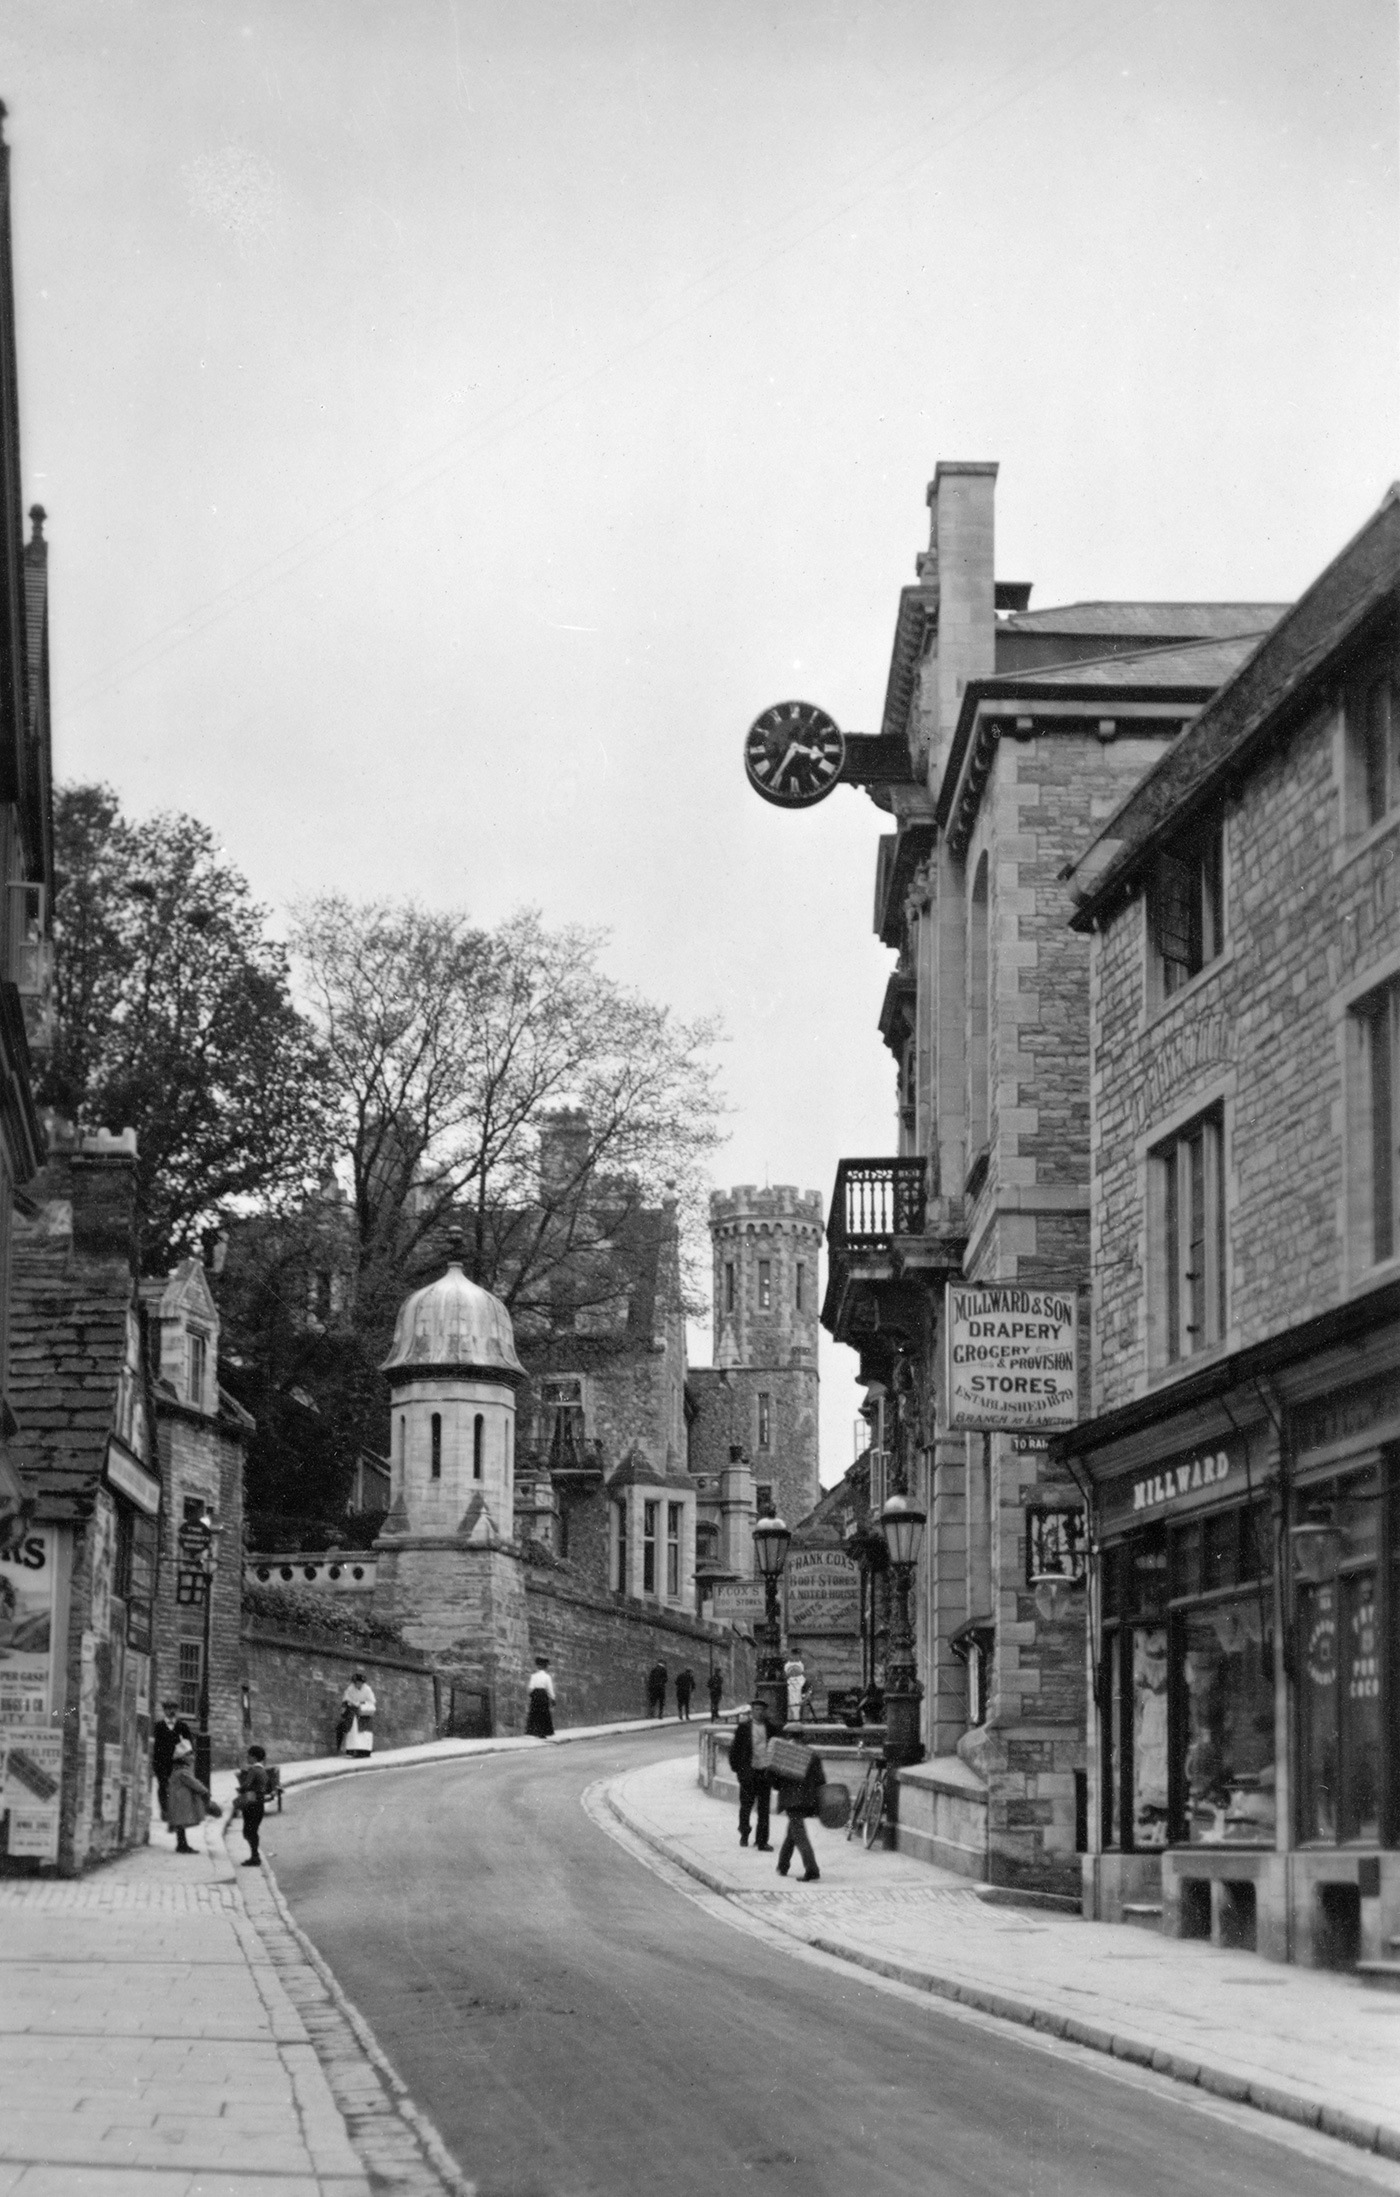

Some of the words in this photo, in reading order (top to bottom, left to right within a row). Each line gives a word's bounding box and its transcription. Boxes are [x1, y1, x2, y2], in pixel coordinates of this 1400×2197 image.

[953, 1291, 1030, 1324] MILLWARD
[1031, 1297, 1043, 1316] &
[1044, 1296, 1072, 1327] SON
[969, 1321, 1063, 1340] DRAPERY
[953, 1344, 1031, 1364] GROCERY
[997, 1358, 1007, 1369] &
[1010, 1351, 1073, 1371] PROVISION
[971, 1375, 1058, 1394] STORES
[954, 1385, 1046, 1412] ESTABLISHED
[955, 1411, 1008, 1424] BRANCH
[1014, 1439, 1026, 1449] TO
[1133, 1451, 1229, 1511] MILLWARD
[788, 1553, 823, 1573] FRANK
[790, 1574, 816, 1587] BOOT
[818, 1573, 858, 1588] STORES
